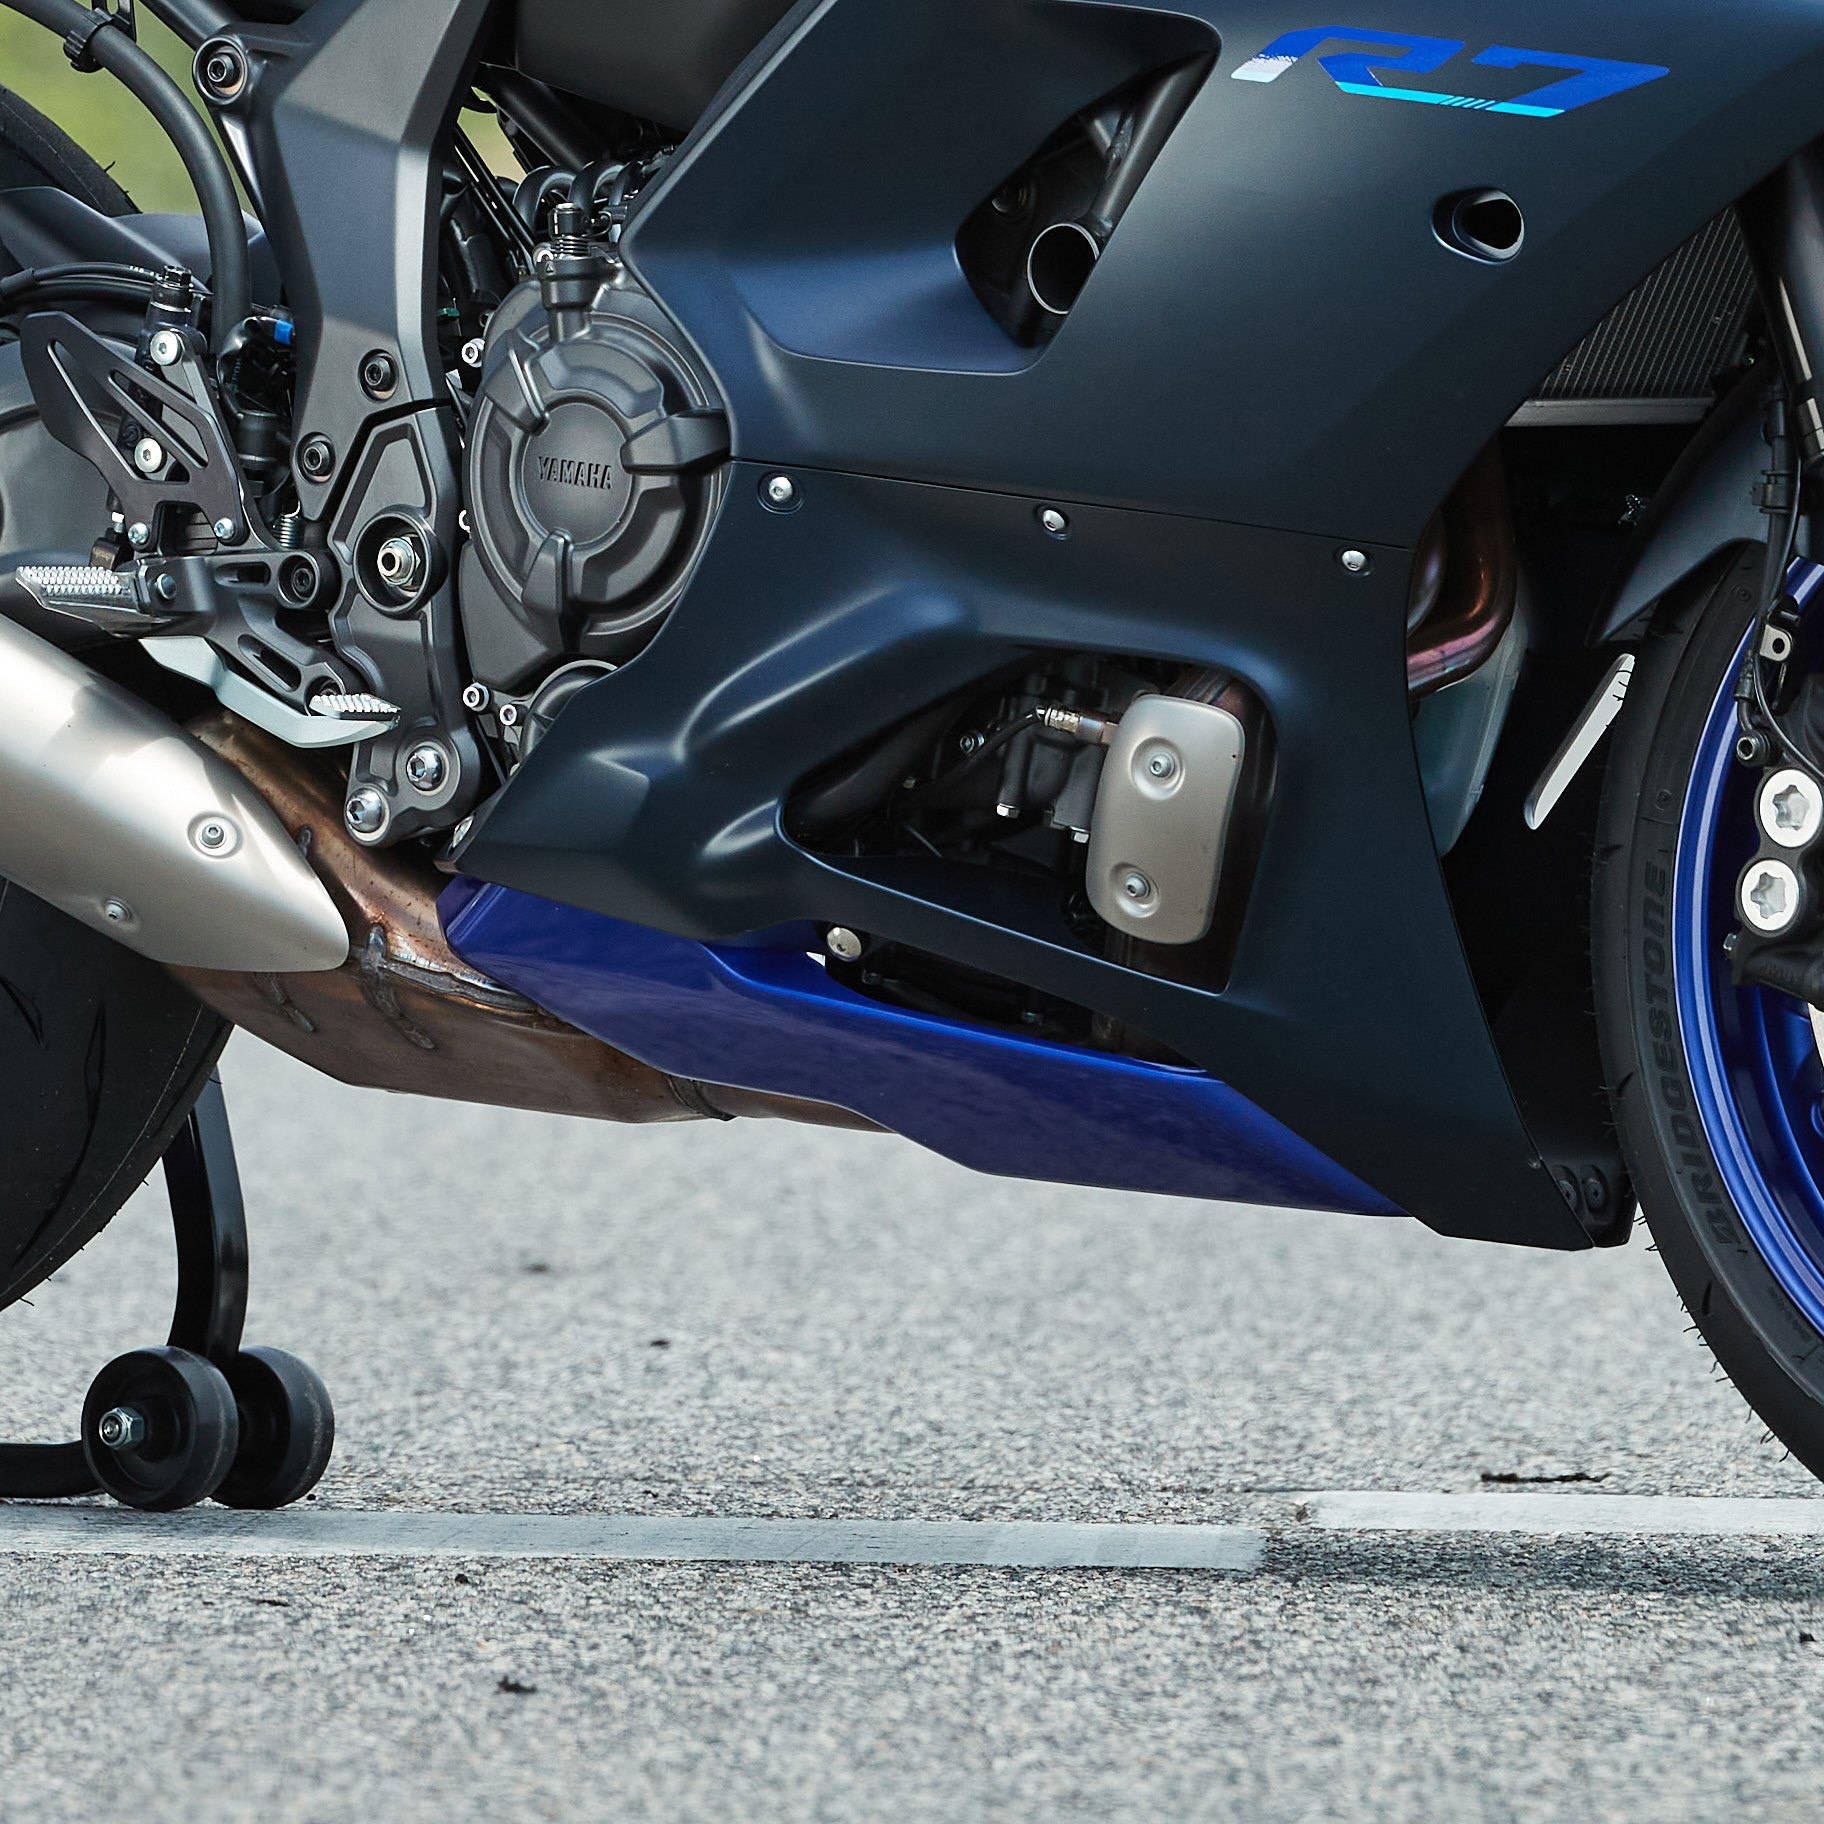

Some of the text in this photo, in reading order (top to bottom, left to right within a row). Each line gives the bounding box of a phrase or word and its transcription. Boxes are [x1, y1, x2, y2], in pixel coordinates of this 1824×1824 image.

[1231, 25, 1670, 117] R7
[538, 456, 614, 490] YAMAHA
[1642, 859, 1745, 1246] BRIDGESTONE
